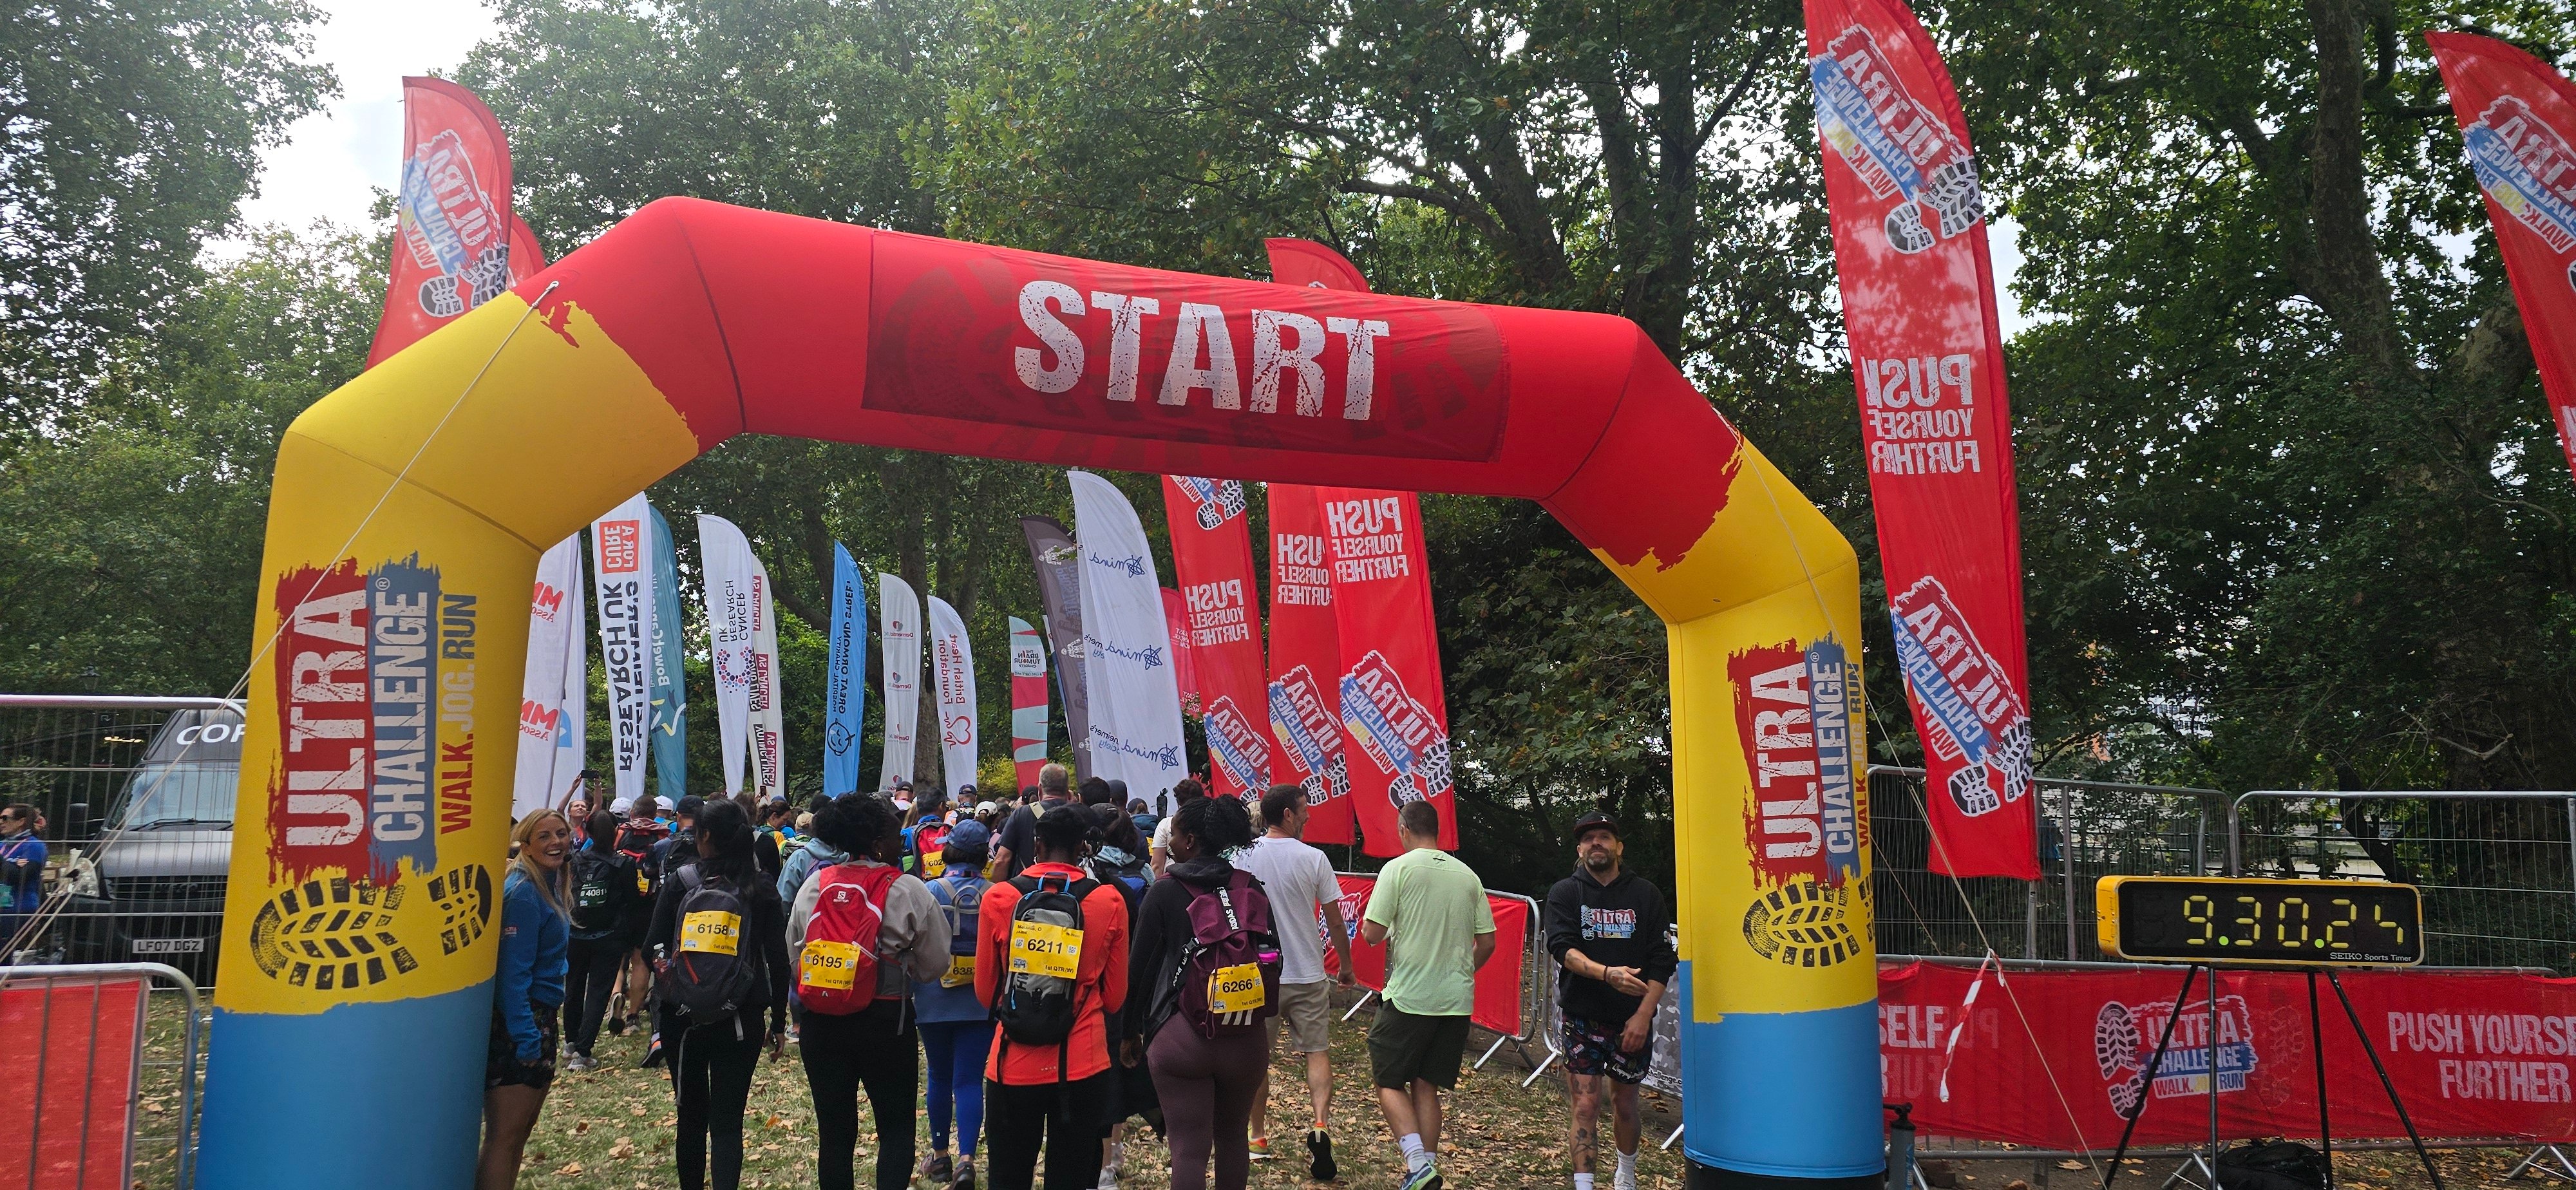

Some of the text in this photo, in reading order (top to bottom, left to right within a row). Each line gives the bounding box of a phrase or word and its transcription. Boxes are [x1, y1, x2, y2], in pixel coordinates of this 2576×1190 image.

[1014, 280, 1390, 421] START
[1846, 662, 1861, 715] RUN
[285, 589, 366, 847] ULTRA
[440, 594, 477, 835] WALK. JOG. RUN
[1750, 662, 1822, 859] ULTRA
[1597, 912, 1632, 923] ULTRA
[697, 923, 728, 935] 6158
[137, 940, 201, 952] LF07 DGZ
[1027, 939, 1063, 954] 6211
[812, 954, 843, 968] 6195
[2330, 952, 2362, 960] SEIKO
[2364, 954, 2389, 962] Sports
[1222, 979, 1253, 993] 6266
[2387, 1012, 2466, 1052] PUSH
[2219, 1073, 2244, 1089] RUN
[2438, 1059, 2571, 1103] FURTHER
